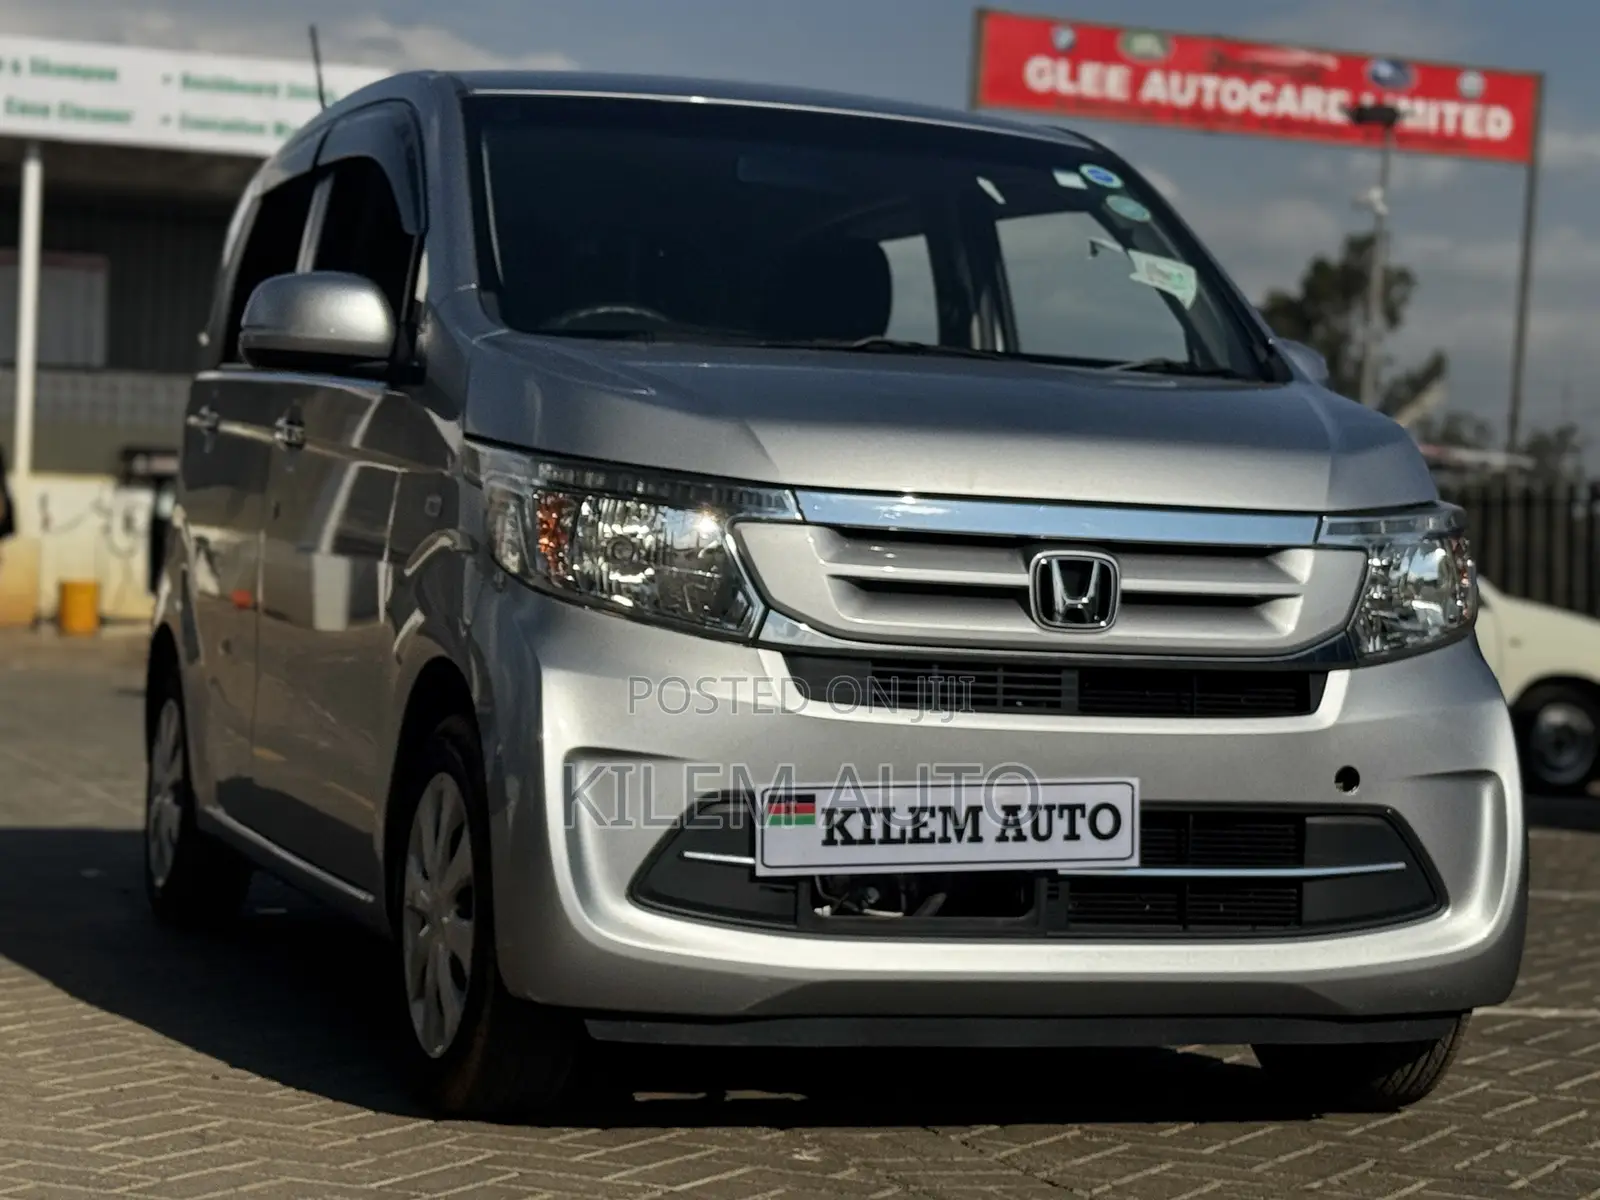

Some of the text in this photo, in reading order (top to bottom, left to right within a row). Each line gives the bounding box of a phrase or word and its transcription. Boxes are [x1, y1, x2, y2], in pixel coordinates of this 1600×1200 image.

[1022, 54, 1131, 101] GLEE
[1139, 70, 1351, 125] AUTOCARE
[820, 802, 1123, 847] KILEM AUTO
